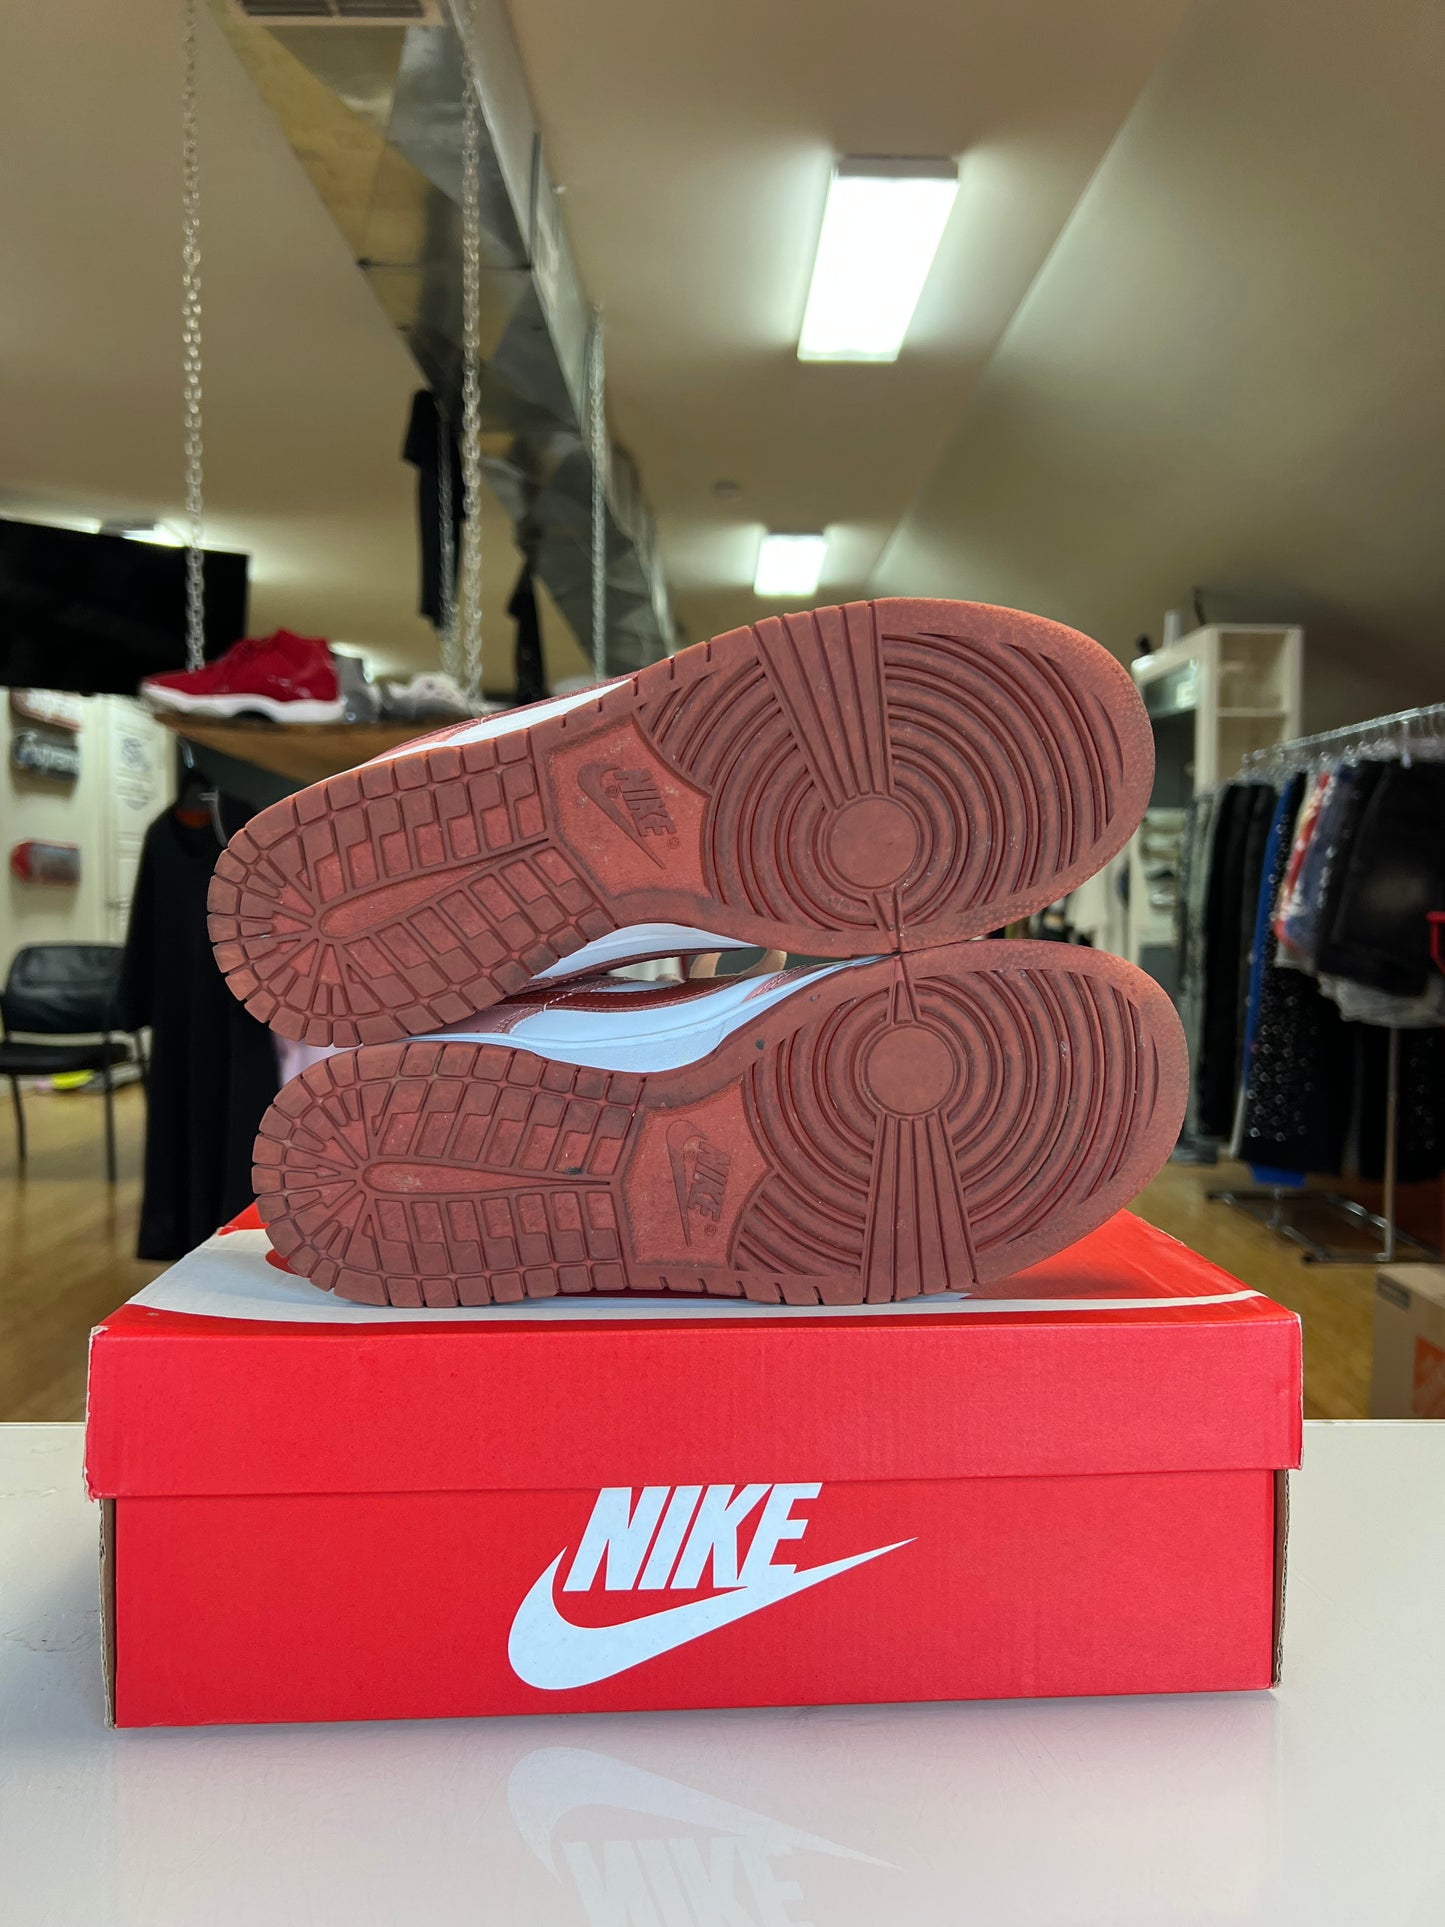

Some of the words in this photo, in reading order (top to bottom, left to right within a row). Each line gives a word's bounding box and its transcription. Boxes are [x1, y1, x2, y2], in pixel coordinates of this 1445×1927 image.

[612, 768, 677, 837] NIKE
[688, 1140, 732, 1222] NIKE
[562, 1482, 823, 1592] NIKE
